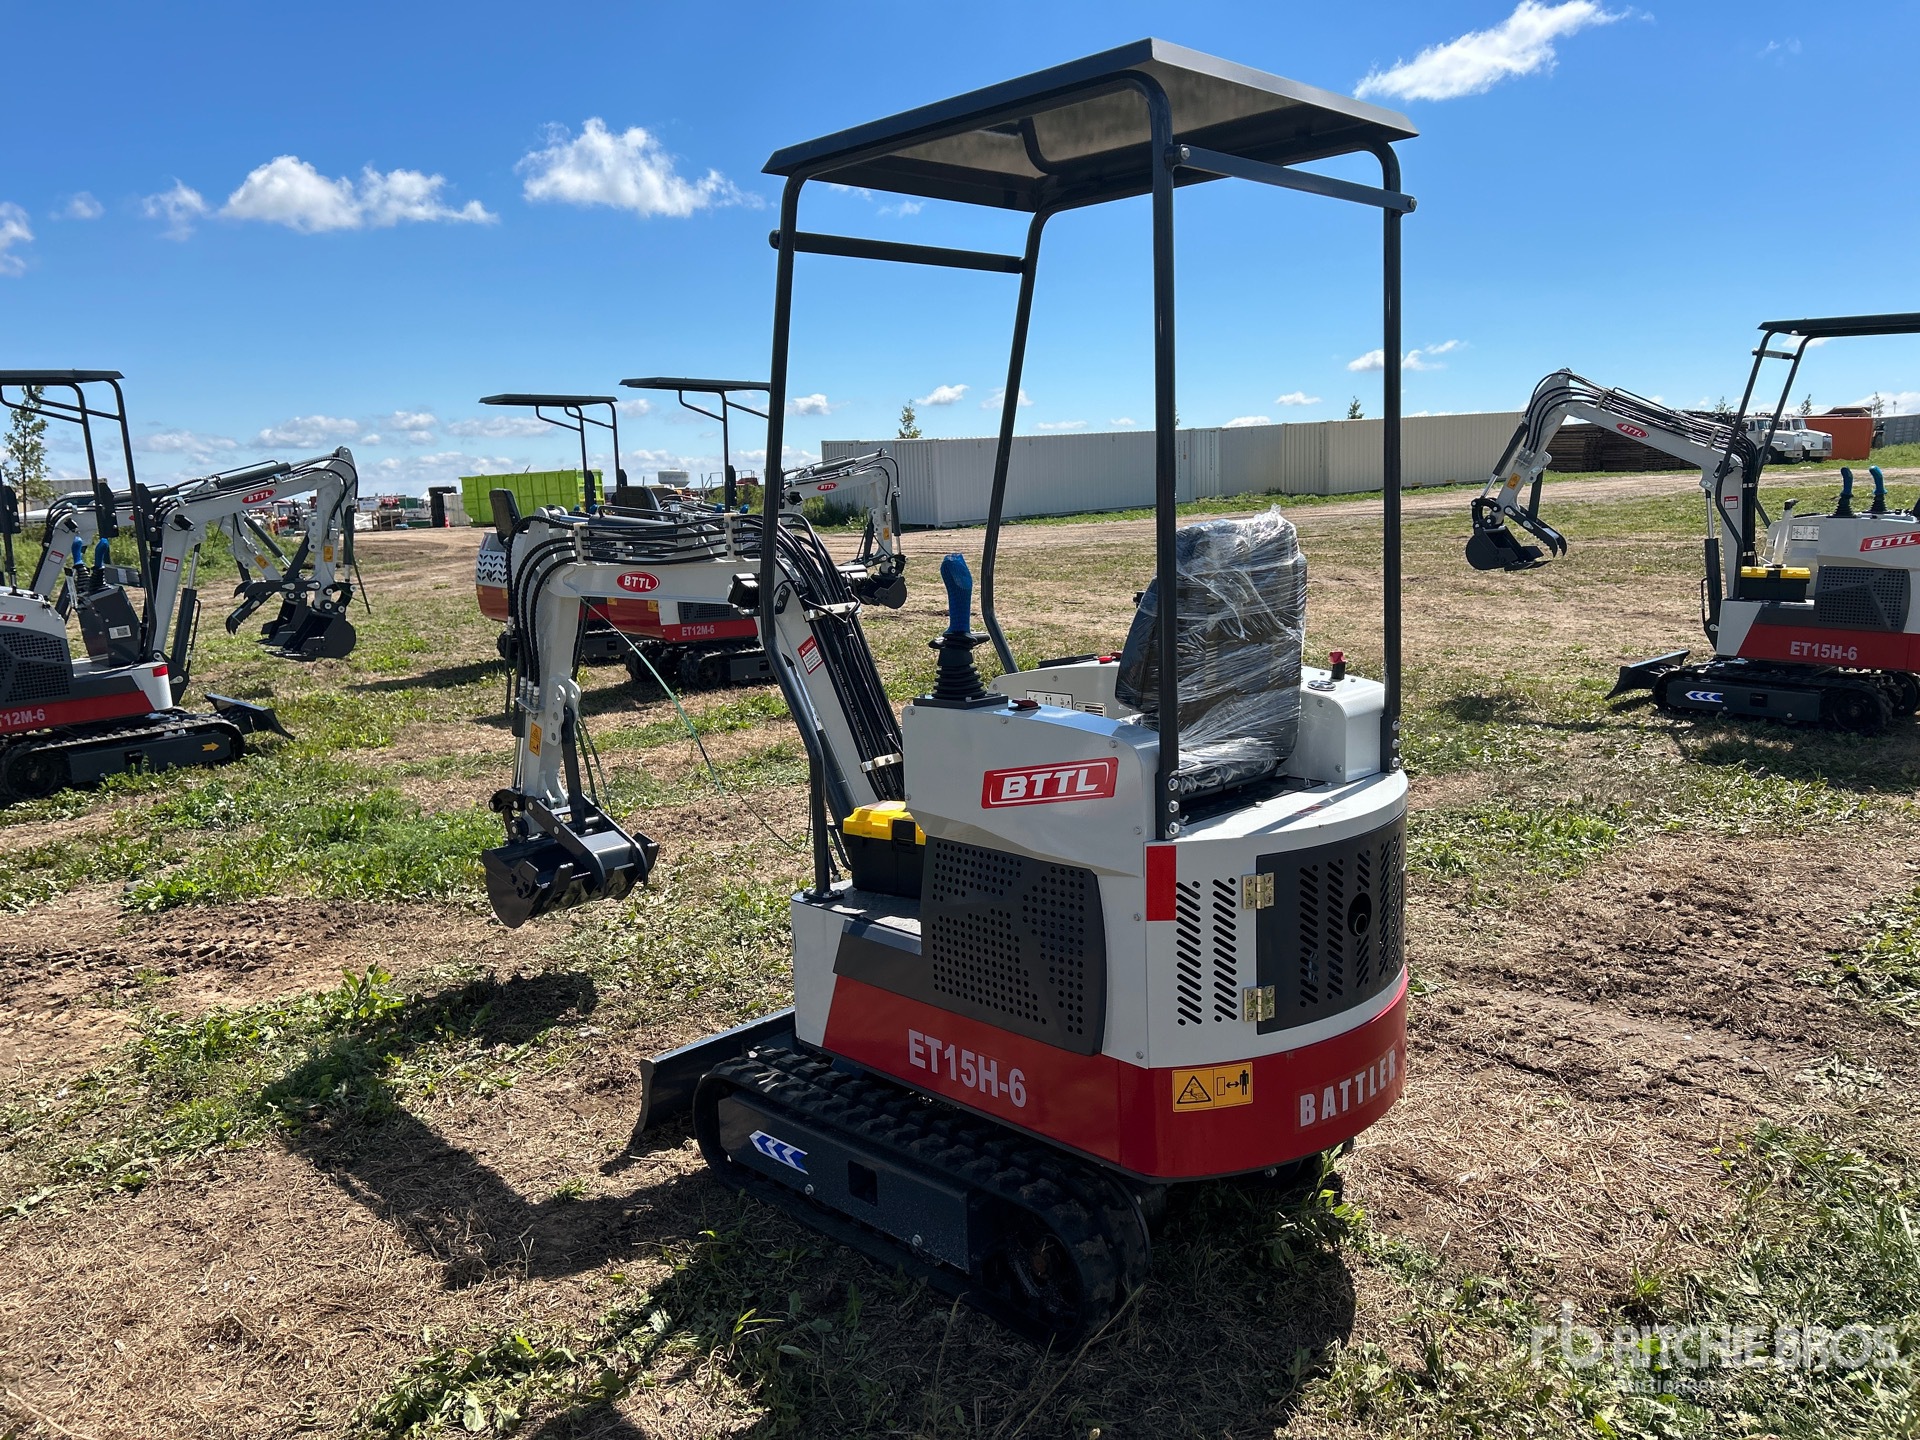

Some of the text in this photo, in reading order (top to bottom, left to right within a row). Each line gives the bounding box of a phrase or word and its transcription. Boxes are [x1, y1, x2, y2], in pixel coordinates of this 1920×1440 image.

[1621, 425, 1642, 437] BTTL
[248, 491, 270, 502] BTTL
[1871, 535, 1916, 548] BTTL
[624, 575, 651, 589] BTTL
[682, 625, 715, 636] ET12M-6
[1790, 641, 1858, 661] ET15H-6
[1001, 769, 1098, 799] BTTL
[908, 1028, 1027, 1108] ET15H-6
[1300, 1049, 1396, 1127] BATTLER
